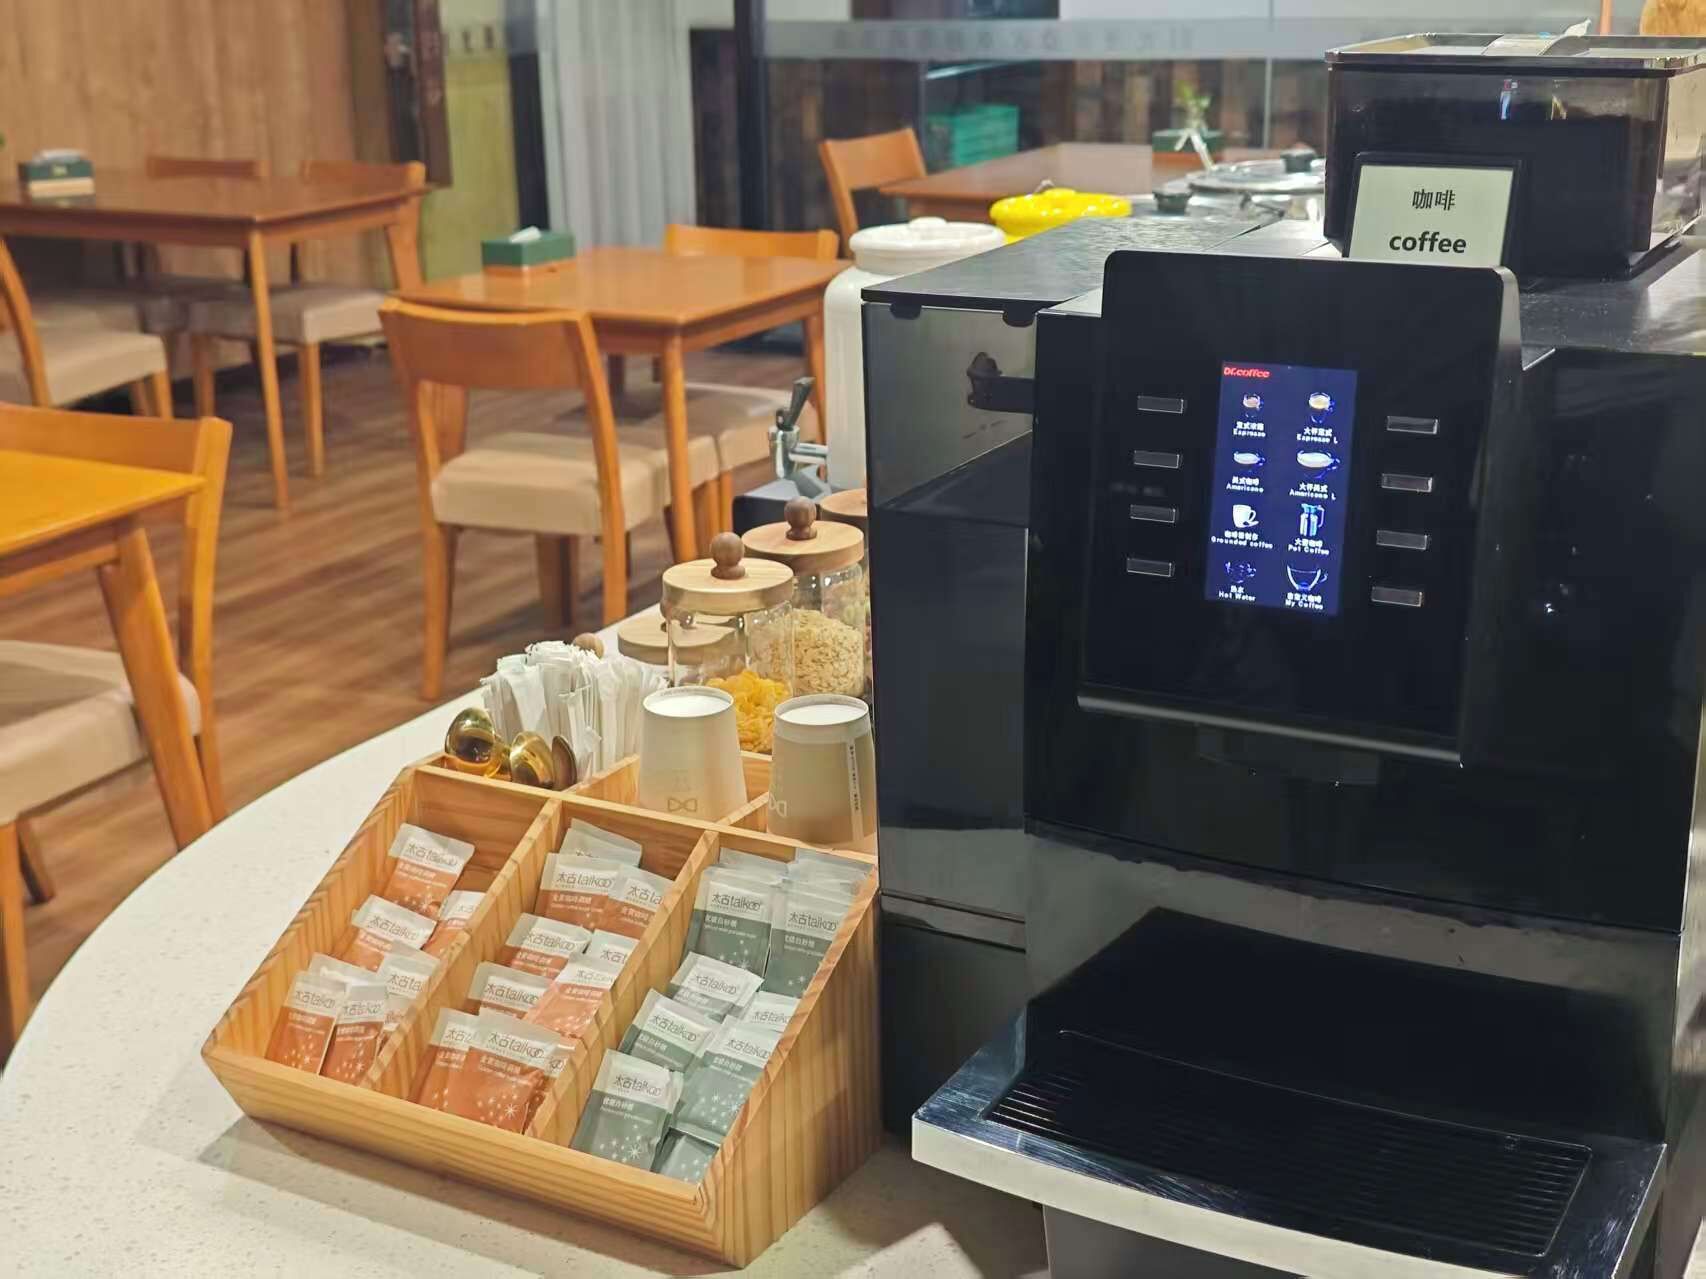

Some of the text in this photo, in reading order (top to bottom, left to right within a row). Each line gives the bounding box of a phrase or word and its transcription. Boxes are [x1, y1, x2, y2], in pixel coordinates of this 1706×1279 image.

[1412, 189, 1456, 211] 咖啡
[1389, 231, 1467, 253] coffee
[1226, 483, 1264, 493] Americano
[1289, 488, 1328, 499] Americano
[1218, 590, 1256, 601] Hot Water
[712, 892, 761, 911] 太古taikoo
[788, 912, 837, 931] 太古taikoo
